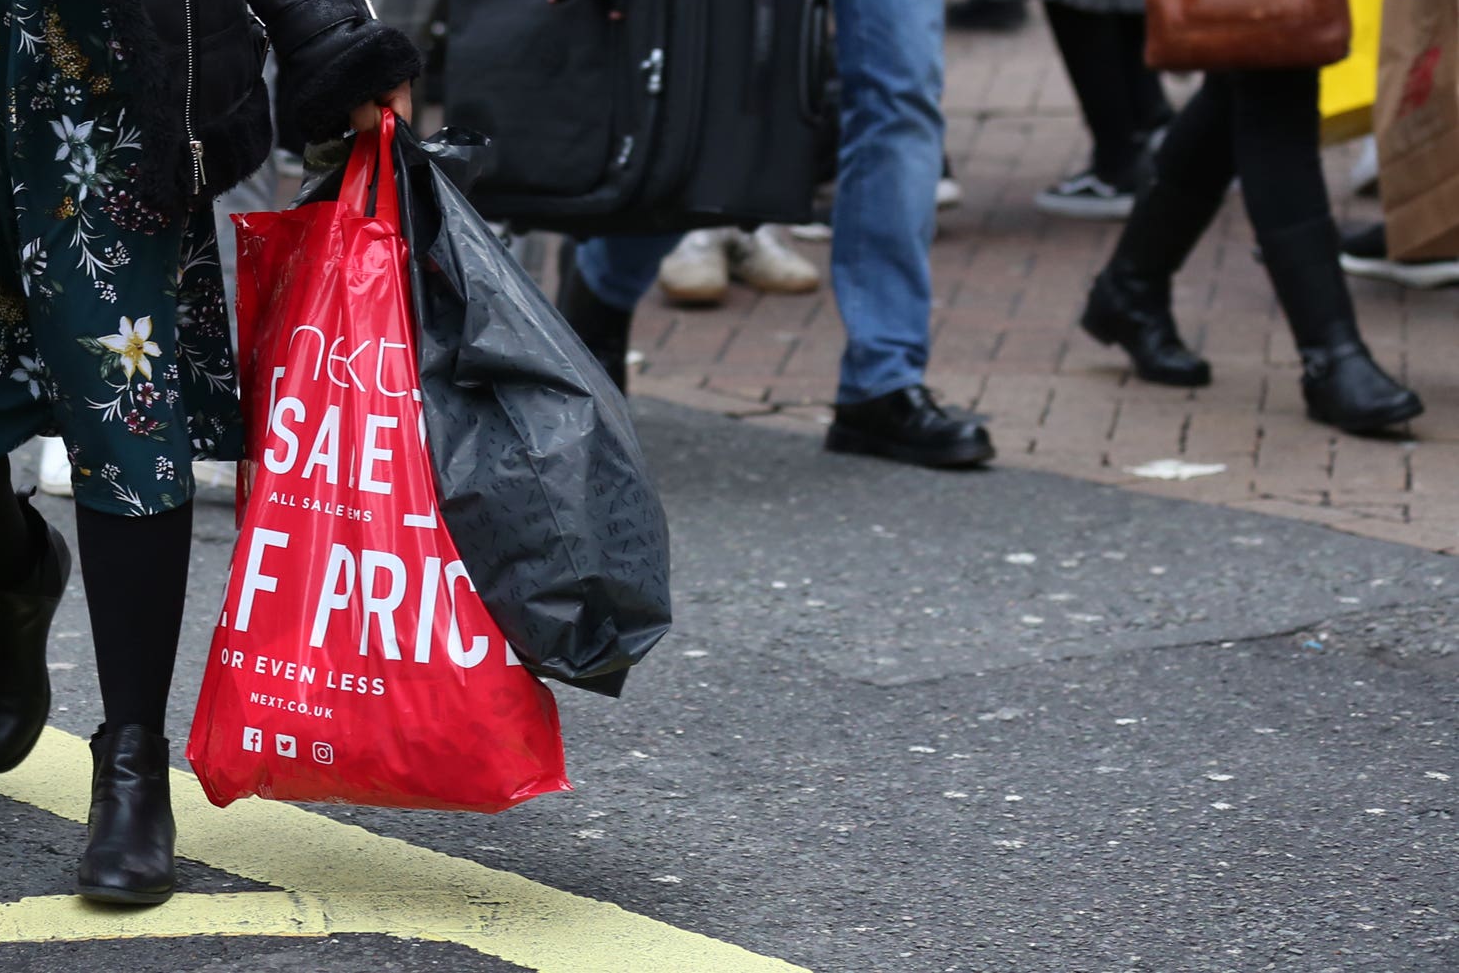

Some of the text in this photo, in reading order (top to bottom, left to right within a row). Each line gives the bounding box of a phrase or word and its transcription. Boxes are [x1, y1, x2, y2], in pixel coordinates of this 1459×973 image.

[288, 324, 408, 397] next
[263, 396, 399, 495] SAE
[268, 491, 373, 522] ALL SALE EMS
[309, 543, 522, 668] PRIC
[221, 647, 385, 696] OR EVEN LESS
[250, 691, 334, 719] NEXT.CO.UK
